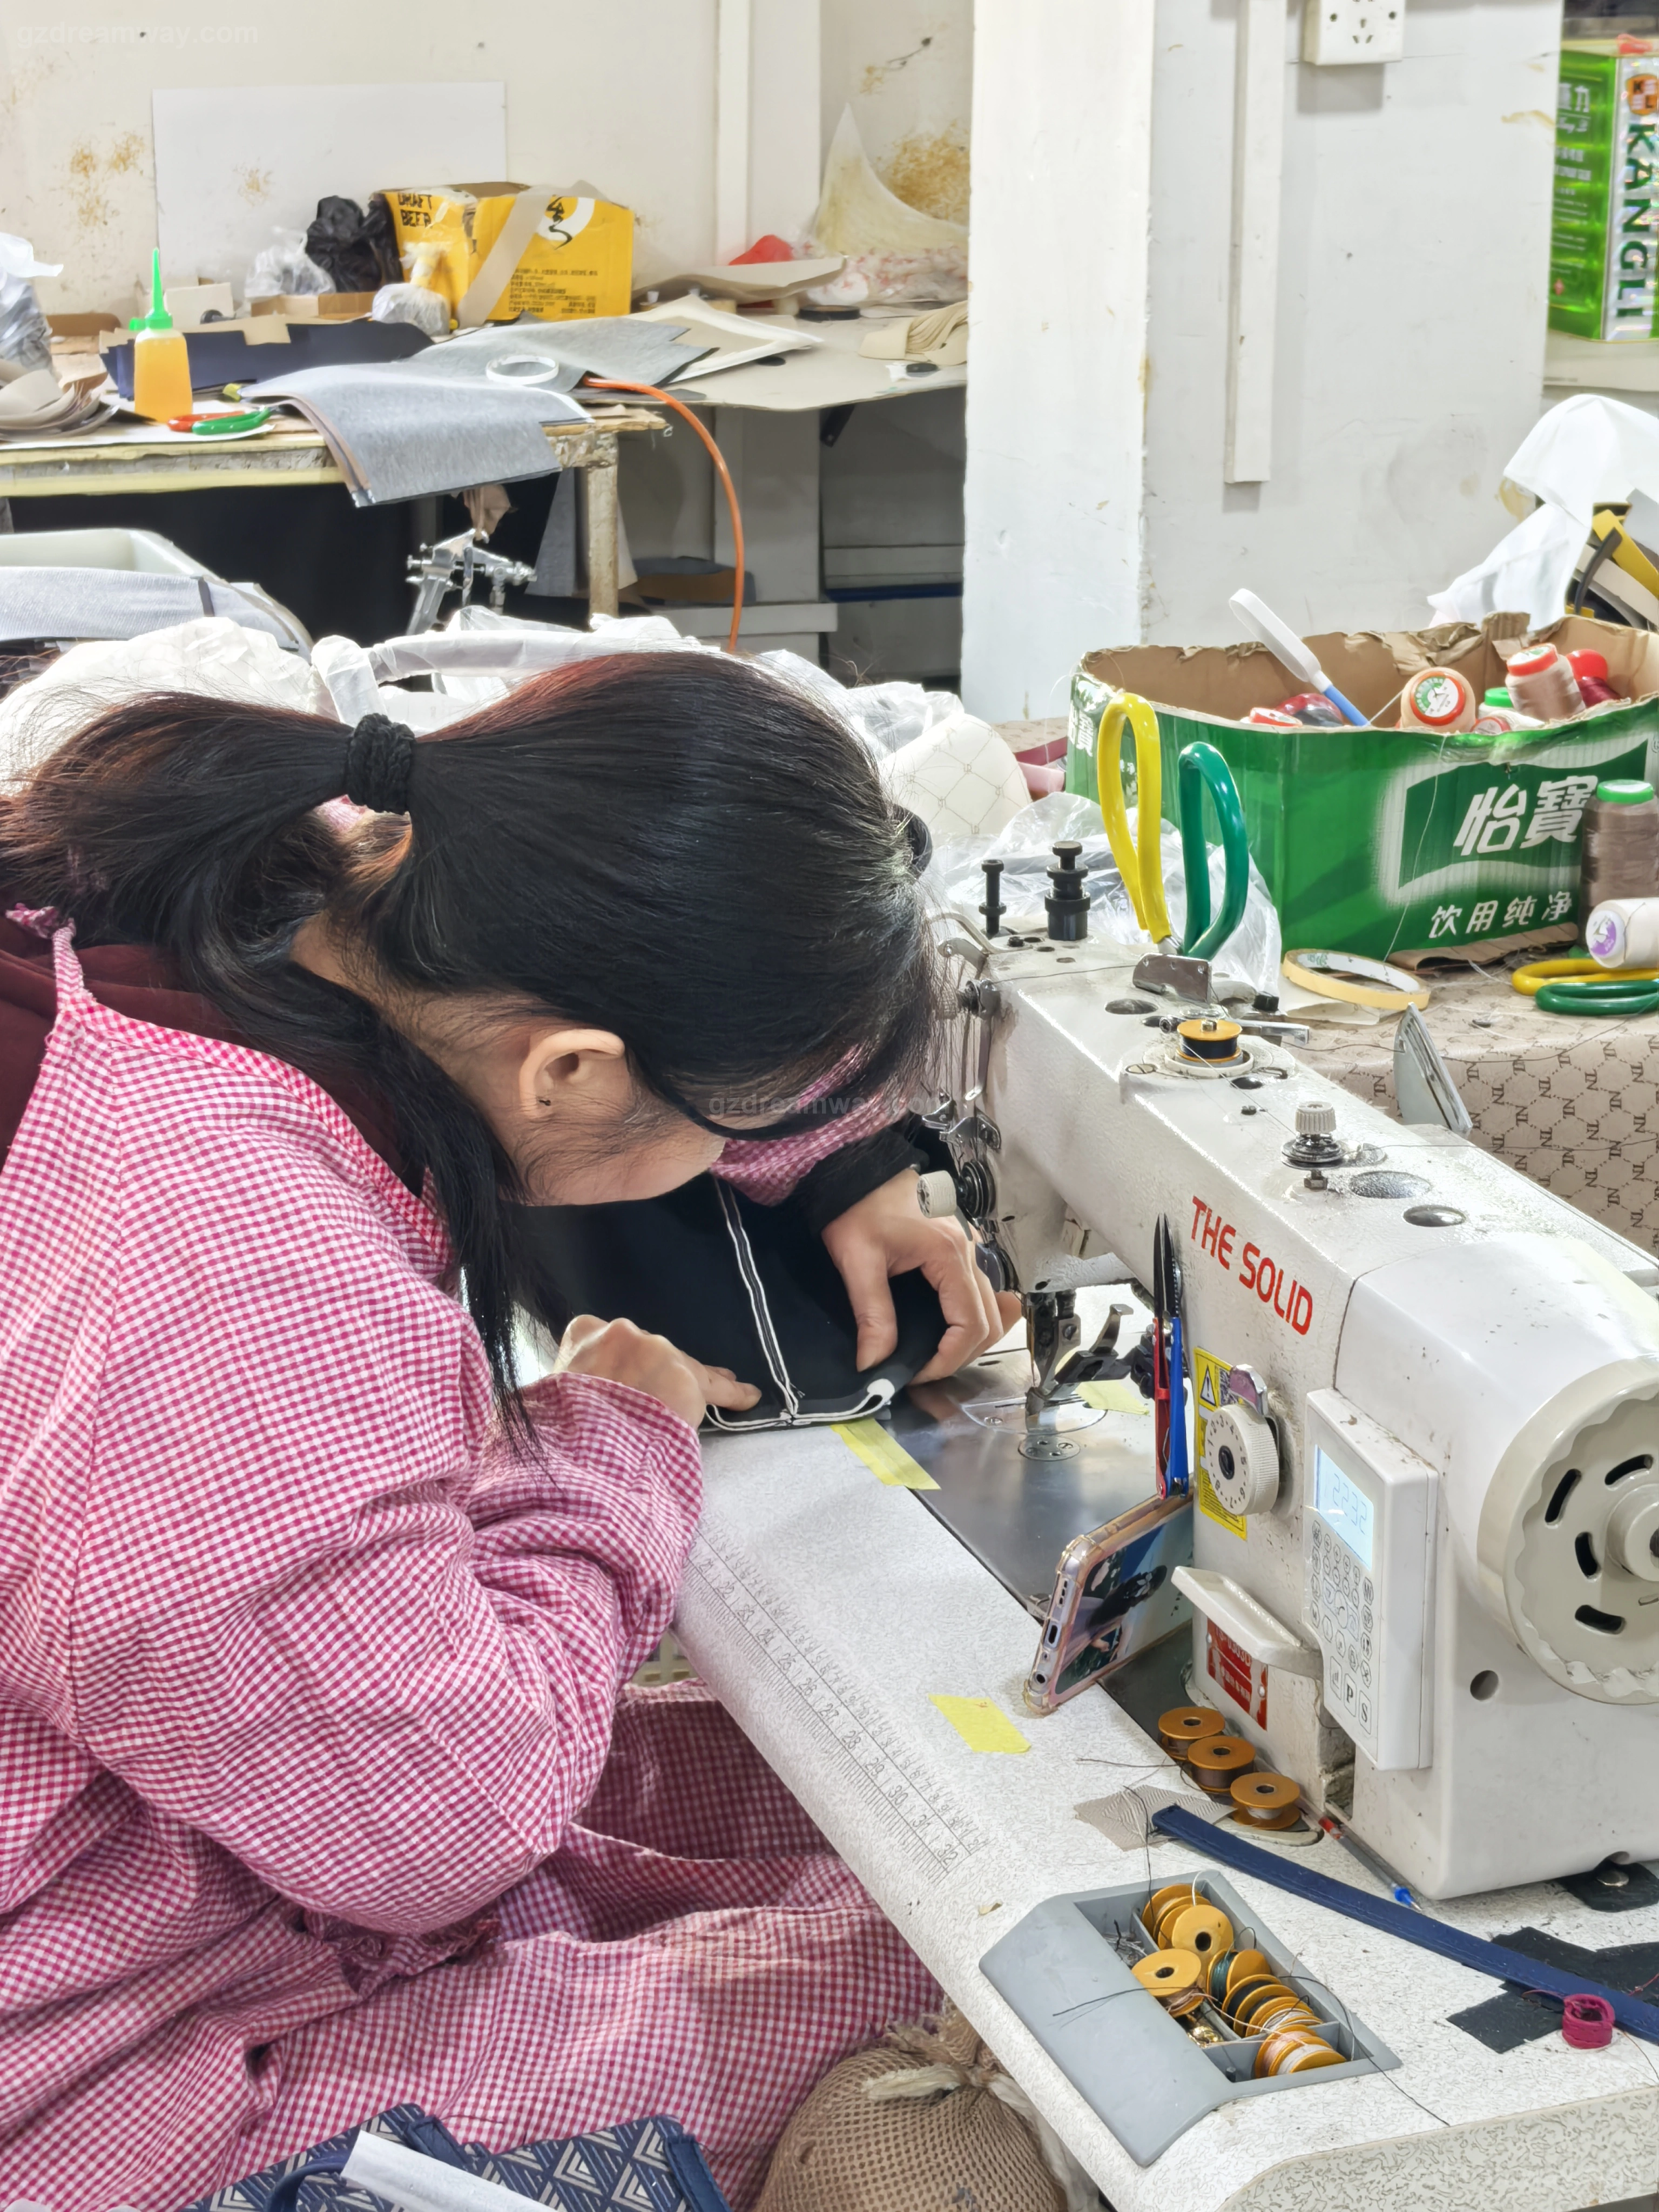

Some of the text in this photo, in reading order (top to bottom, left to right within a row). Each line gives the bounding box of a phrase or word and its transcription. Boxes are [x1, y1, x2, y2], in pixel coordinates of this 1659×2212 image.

[1617, 124, 1656, 318] KANGLI
[1428, 891, 1573, 939] 饮用纯净
[1191, 1195, 1313, 1335] THE SOLID
[718, 1582, 734, 1597] 22
[820, 1704, 838, 1722] 27
[842, 1730, 861, 1748] 28
[866, 1758, 884, 1776] 29
[888, 1785, 908, 1805] 30
[913, 1815, 930, 1832] 31
[938, 1844, 957, 1864] 32
[1346, 1683, 1354, 1703] P
[1361, 1702, 1368, 1723] S
